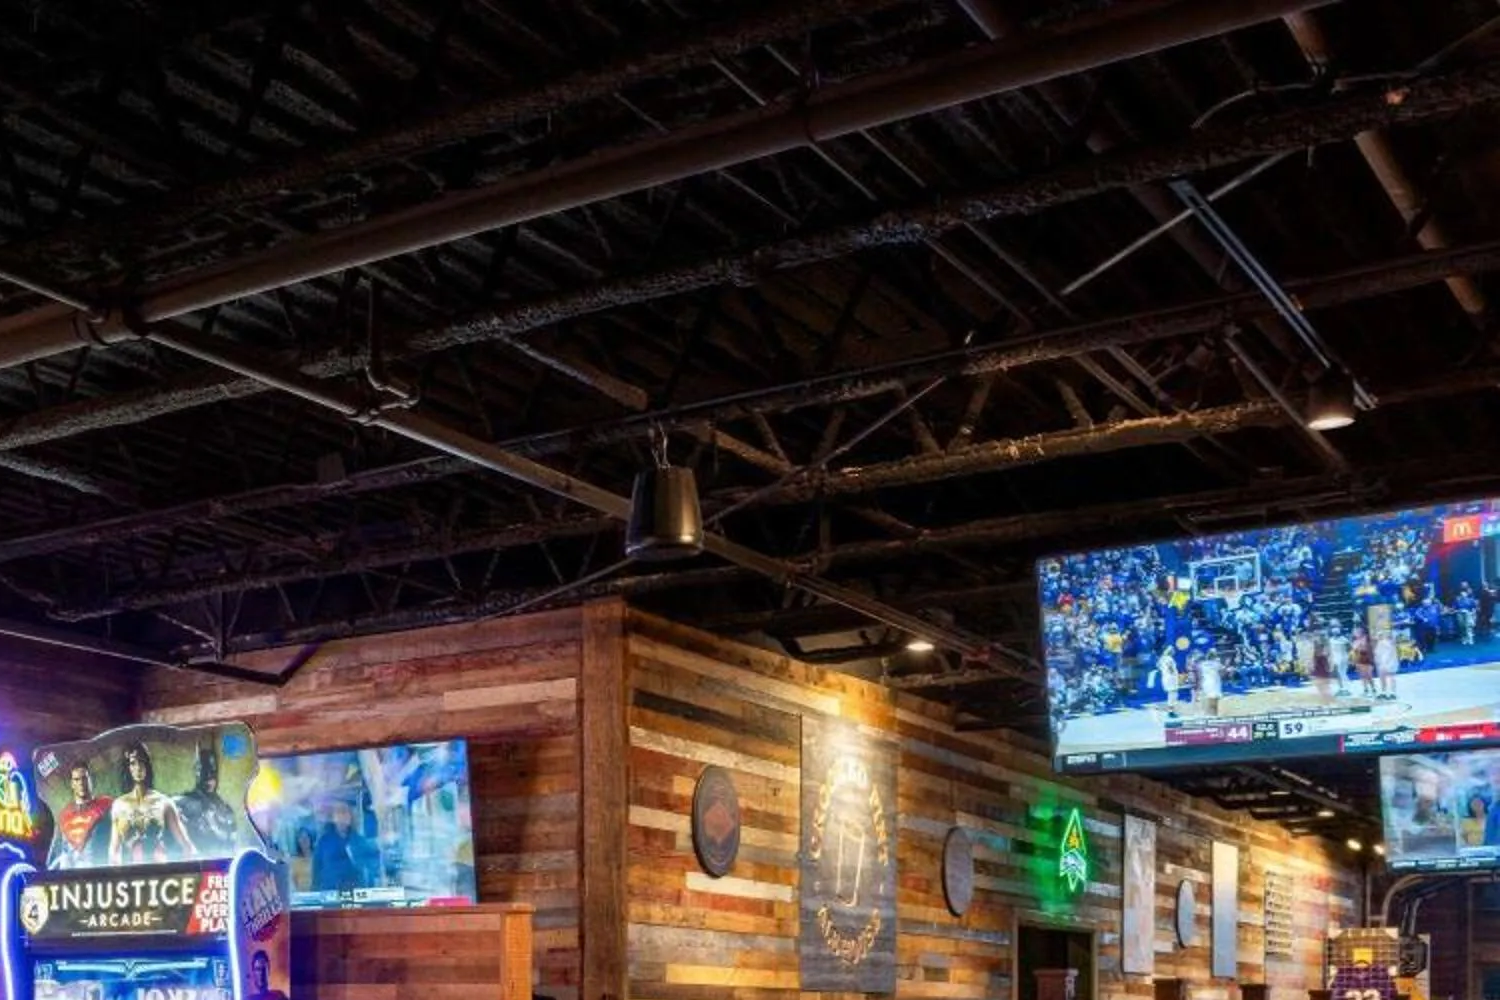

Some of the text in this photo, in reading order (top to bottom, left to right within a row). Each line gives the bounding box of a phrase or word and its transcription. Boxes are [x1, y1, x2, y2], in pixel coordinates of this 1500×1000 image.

[1227, 726, 1249, 739] 44
[1284, 722, 1303, 735] 59
[207, 875, 229, 889] FRE
[50, 877, 194, 911] INJUSTICE
[200, 889, 229, 903] CAR
[196, 903, 229, 918] EVER
[87, 911, 152, 928] ARCADE
